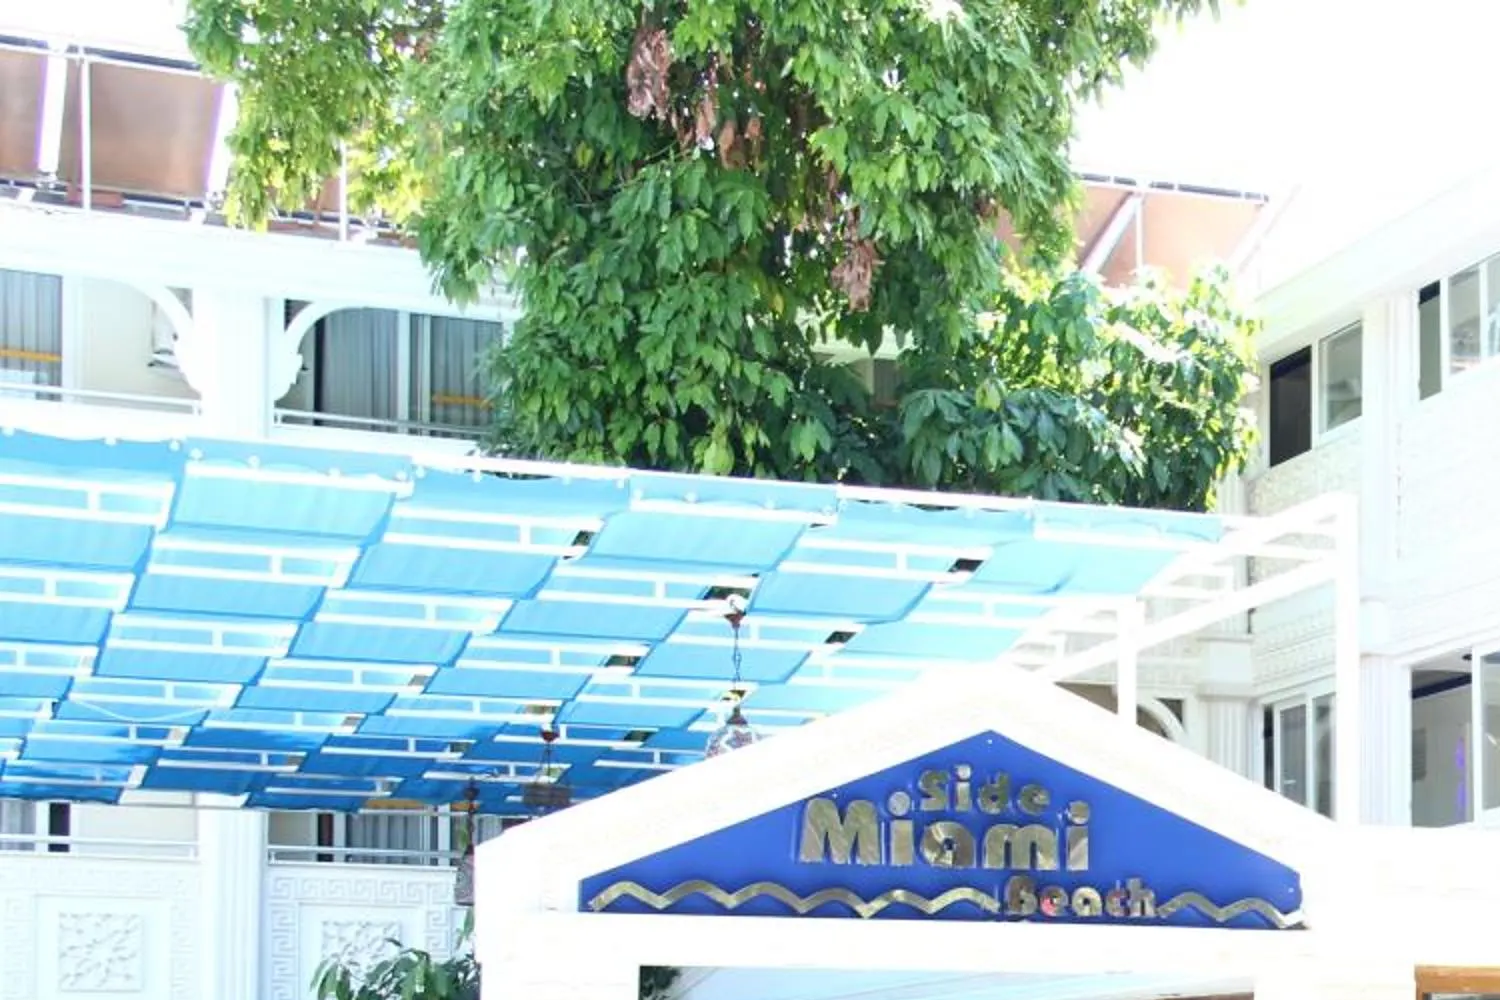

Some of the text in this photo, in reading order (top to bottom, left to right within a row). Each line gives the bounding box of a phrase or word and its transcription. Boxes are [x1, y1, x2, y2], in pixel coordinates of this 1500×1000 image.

[917, 765, 1050, 815] Side
[799, 790, 1090, 871] Miami
[1003, 874, 1156, 918] Beach
